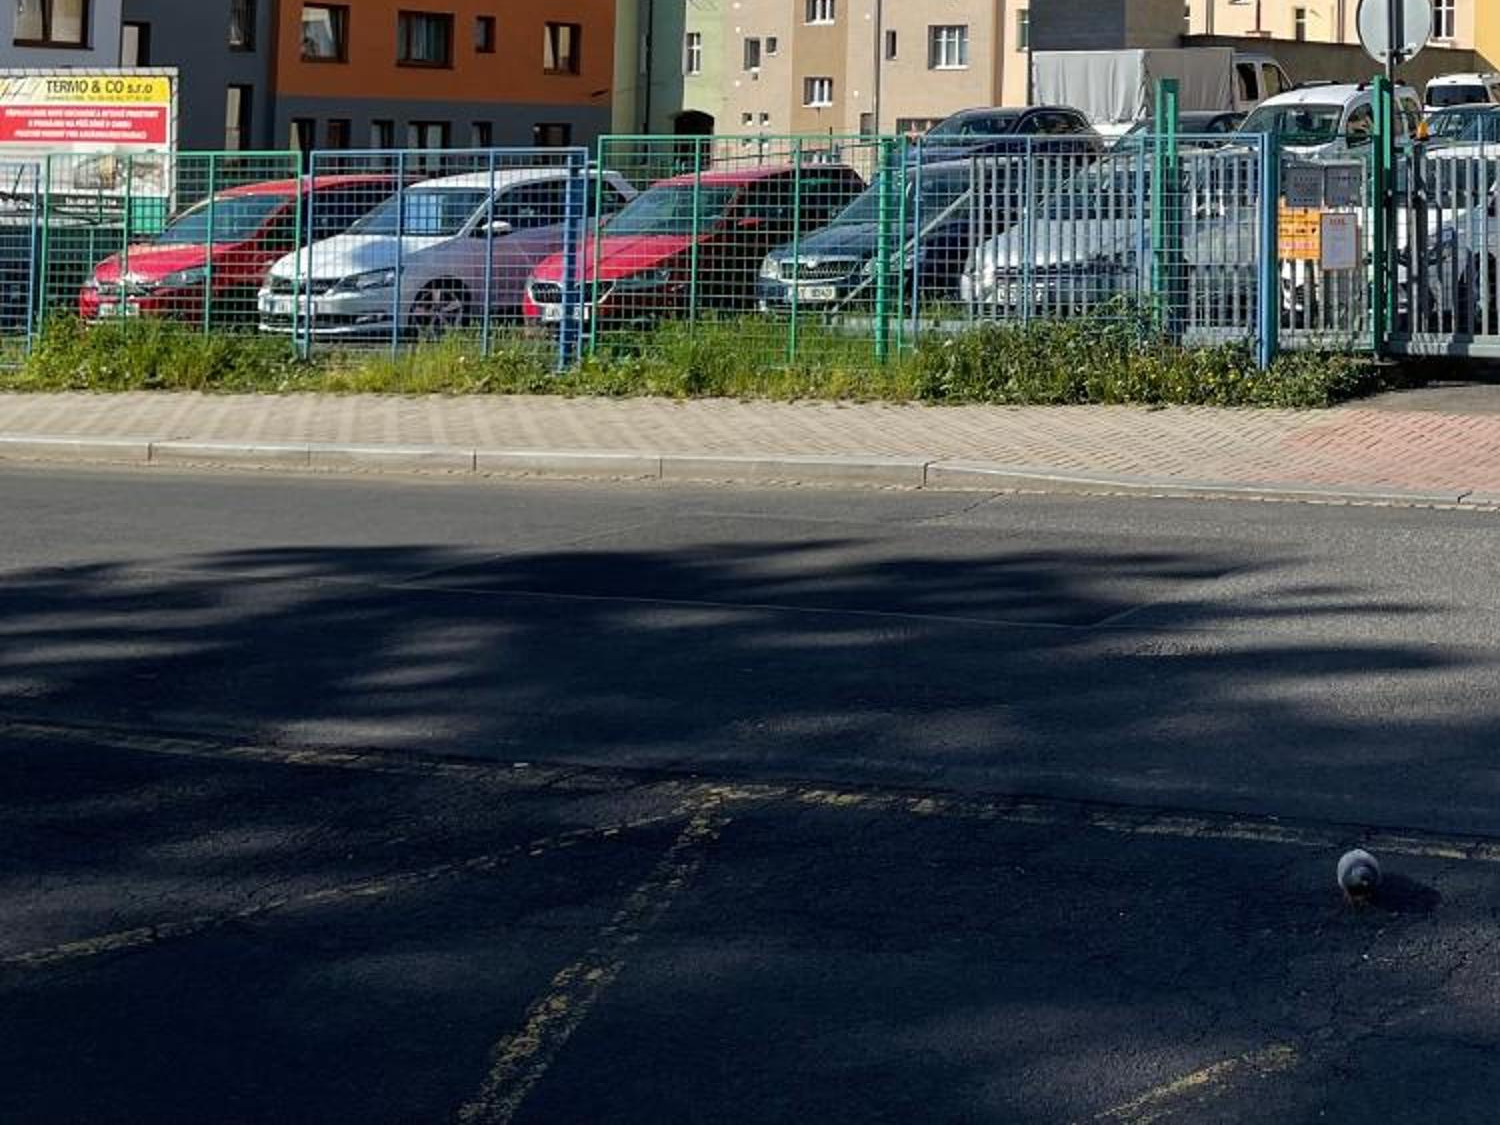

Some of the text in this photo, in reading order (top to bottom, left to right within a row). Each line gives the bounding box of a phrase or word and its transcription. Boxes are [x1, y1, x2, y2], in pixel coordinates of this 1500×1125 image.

[46, 80, 89, 93] TERMO
[91, 80, 101, 93] &
[105, 80, 125, 93] CO
